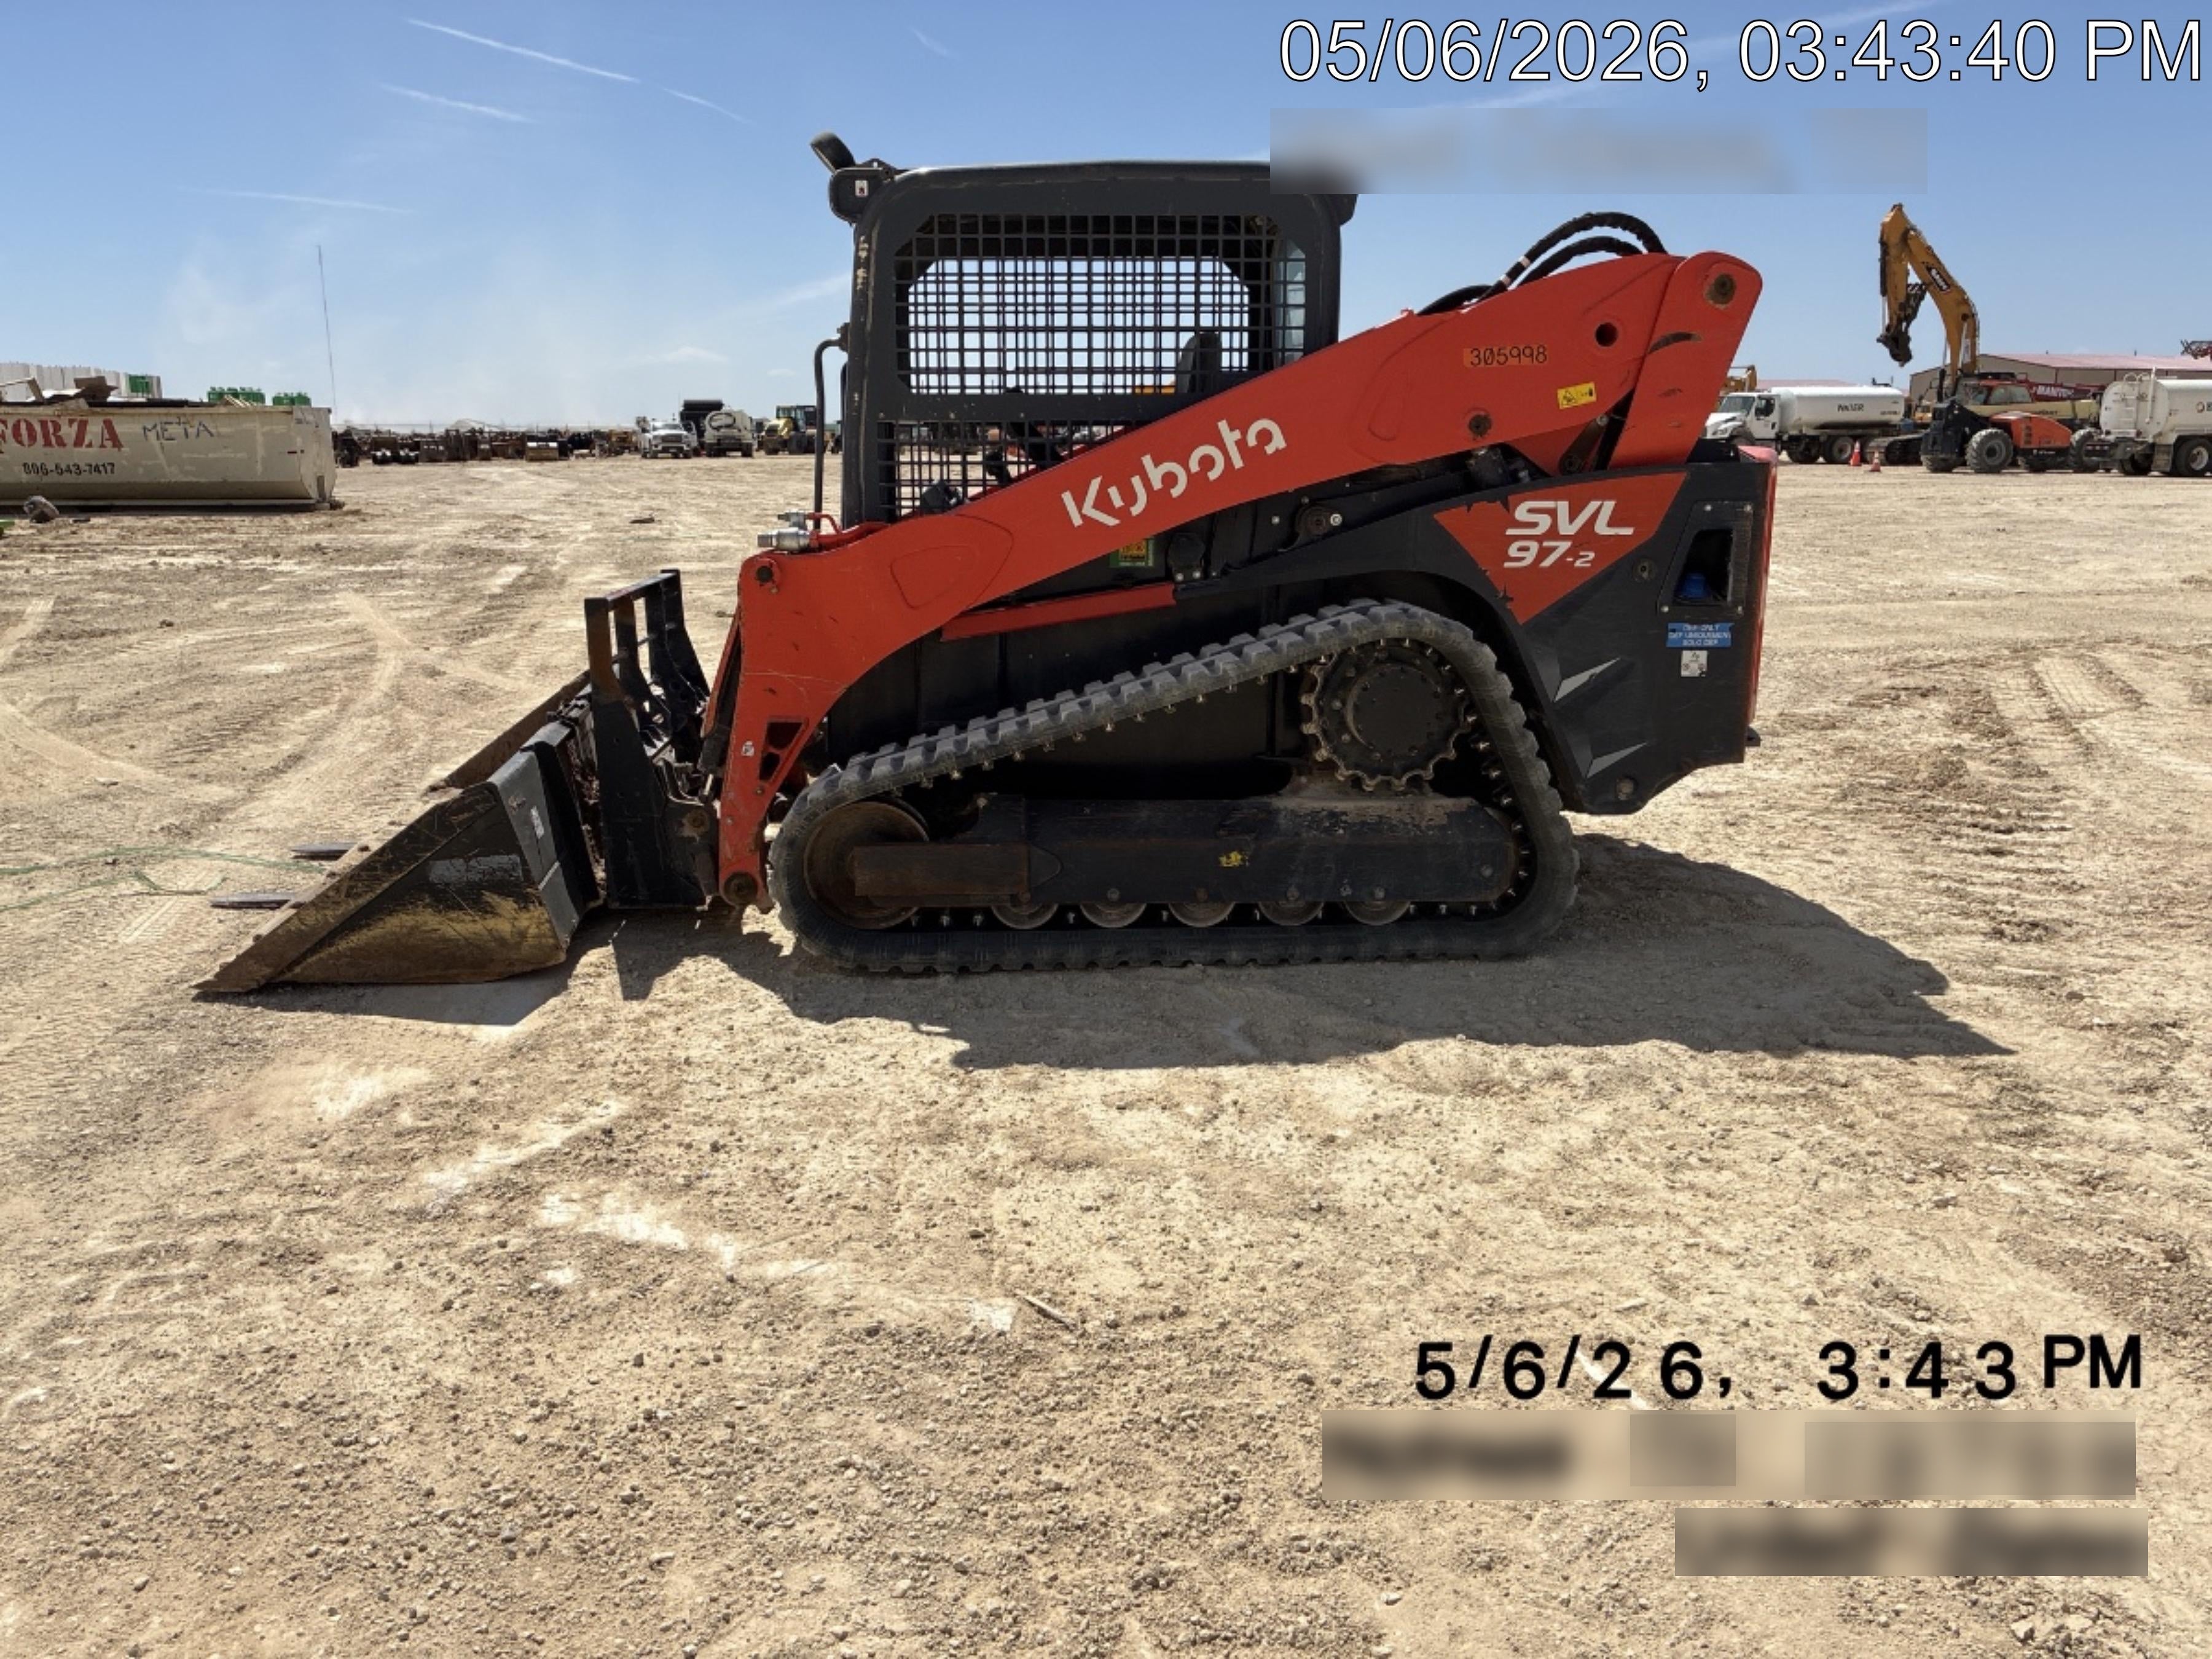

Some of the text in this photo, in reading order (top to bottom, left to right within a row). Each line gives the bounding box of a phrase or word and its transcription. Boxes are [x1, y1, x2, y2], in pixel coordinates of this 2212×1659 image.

[1470, 345, 1548, 366] 305998
[1061, 418, 1287, 528] Kubota
[1505, 500, 1636, 536] SVL
[1503, 539, 1596, 568] 97-2
